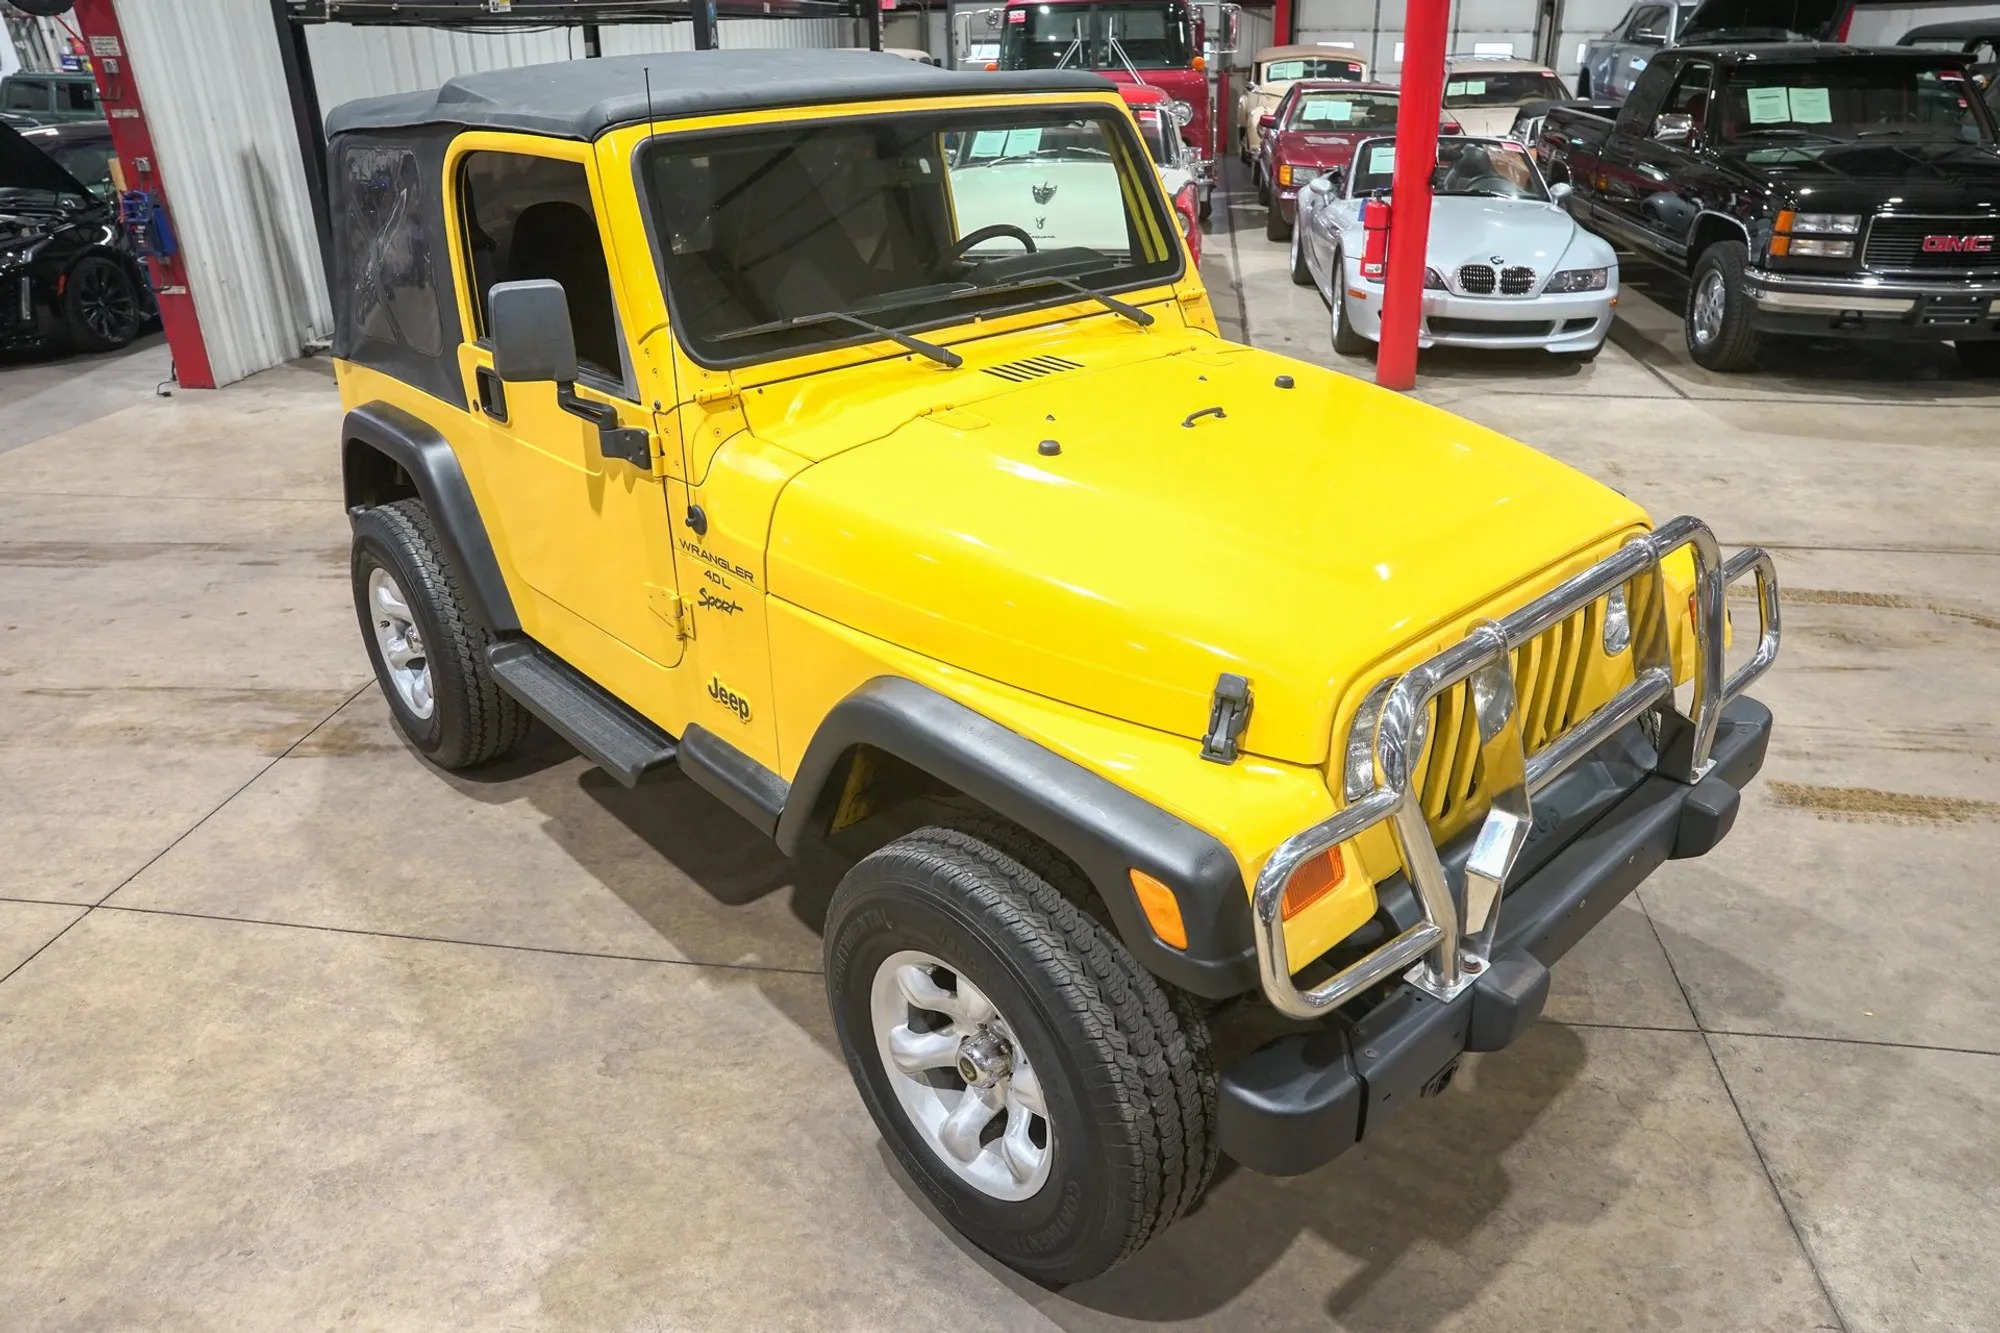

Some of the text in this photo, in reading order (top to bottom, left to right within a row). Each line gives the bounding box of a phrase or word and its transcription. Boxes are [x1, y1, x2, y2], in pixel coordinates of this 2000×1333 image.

[1922, 235, 1994, 251] GMC
[679, 538, 754, 583] WRANGLER
[698, 588, 743, 616] Sport
[708, 676, 749, 720] Jeep
